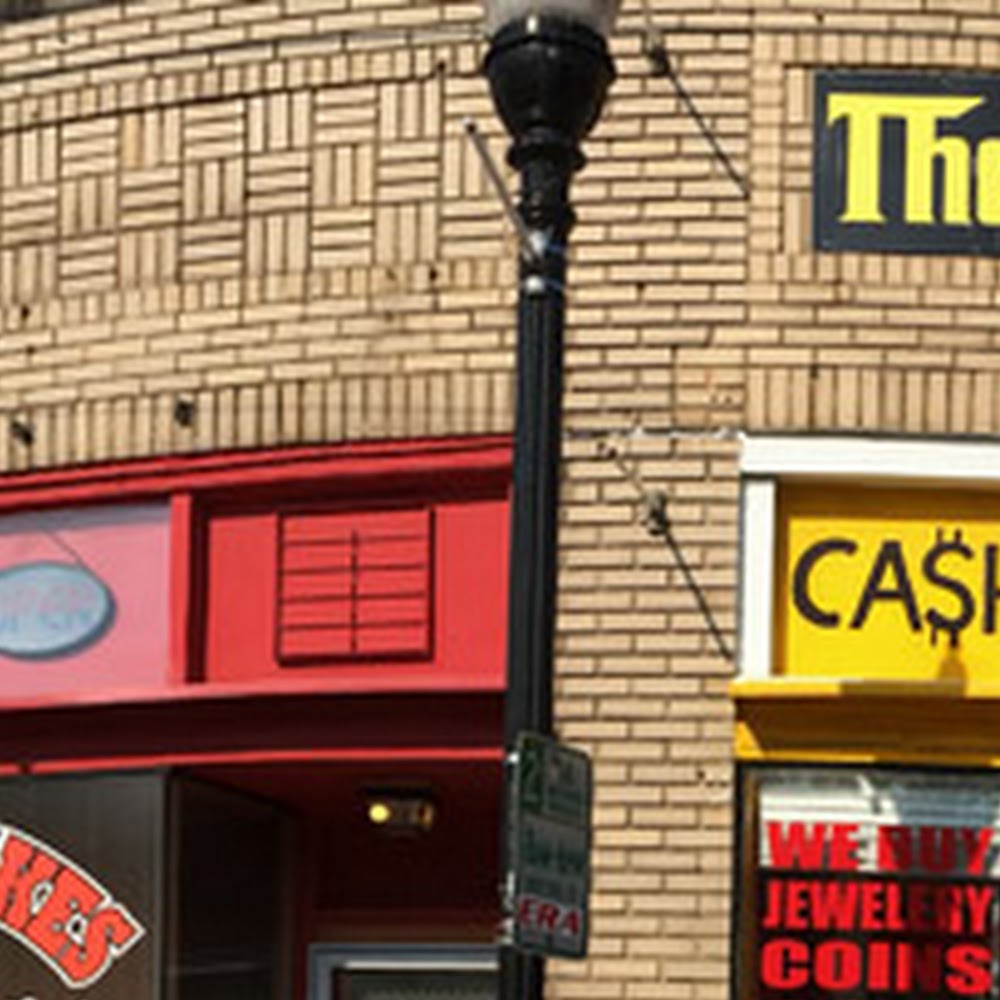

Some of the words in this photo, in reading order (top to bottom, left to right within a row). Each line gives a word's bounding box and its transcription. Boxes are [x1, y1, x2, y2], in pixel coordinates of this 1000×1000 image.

[766, 820, 861, 872] WE
[876, 824, 995, 876] BUY
[761, 937, 993, 995] COINS
